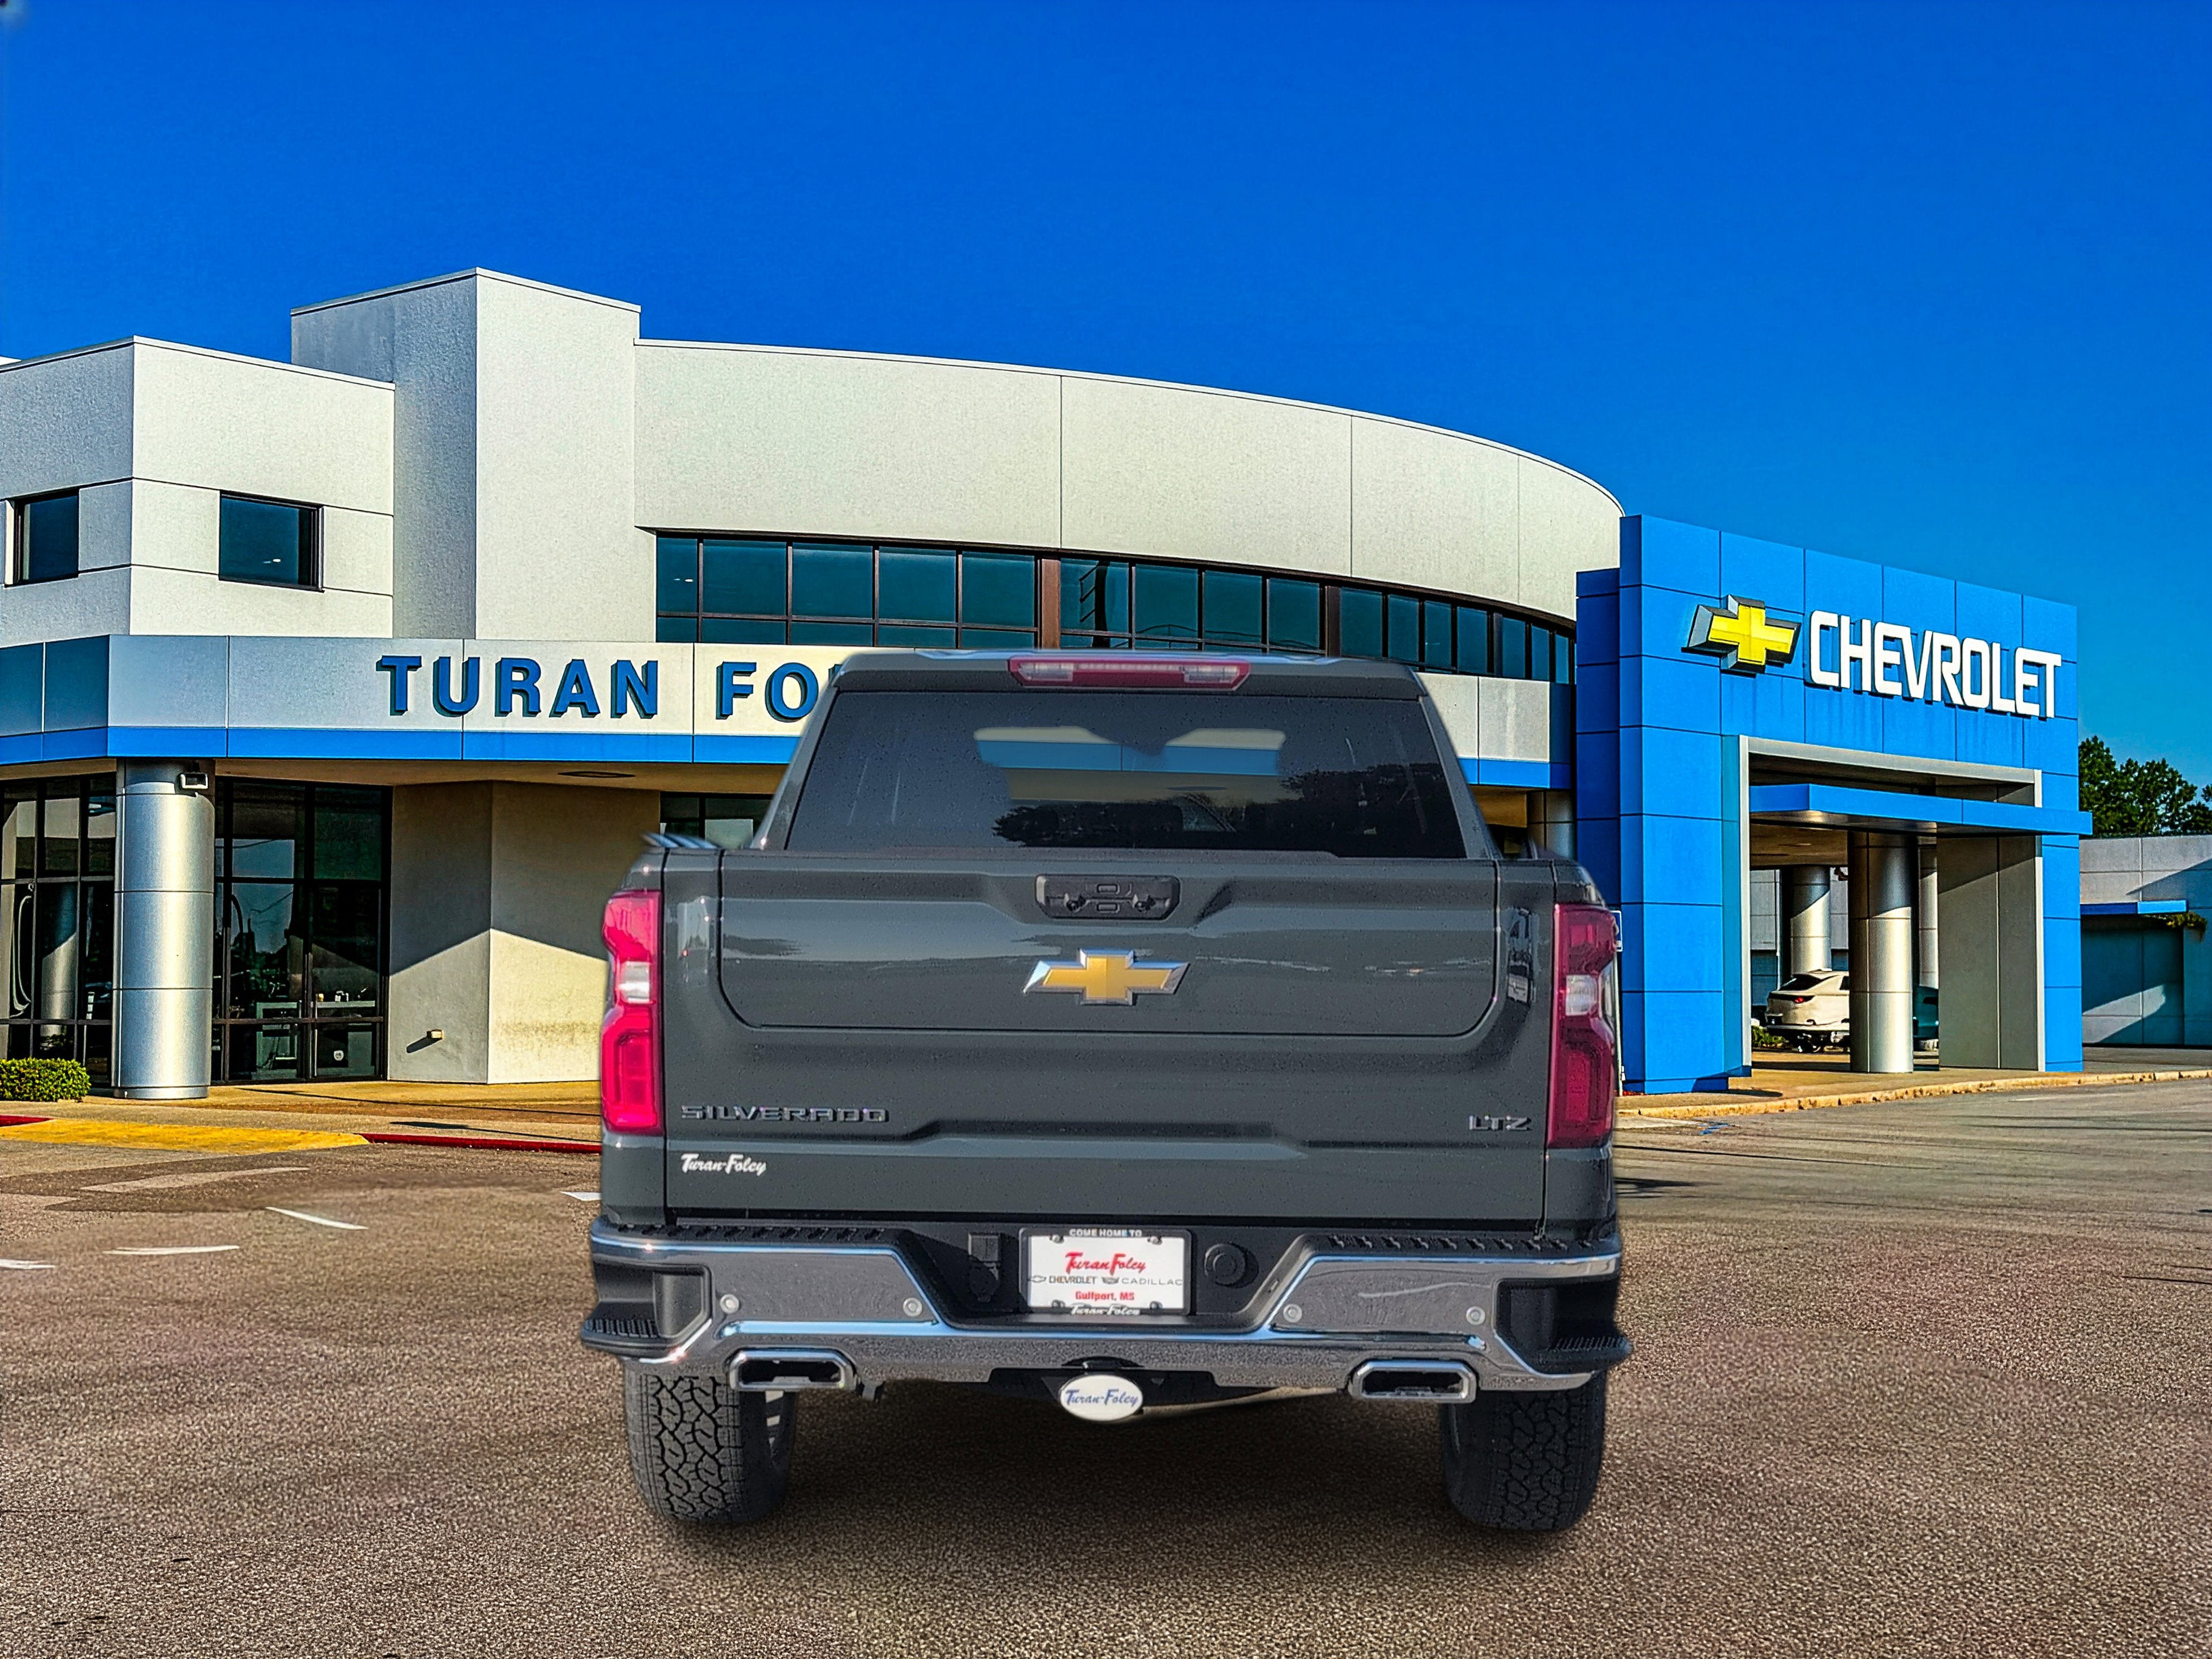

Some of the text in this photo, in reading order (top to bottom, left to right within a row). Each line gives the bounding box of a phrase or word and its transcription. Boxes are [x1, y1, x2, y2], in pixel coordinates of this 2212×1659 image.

[1809, 610, 2062, 718] CHEVROLET
[376, 654, 842, 722] TURAN FO
[681, 1104, 890, 1122] SILVERADO
[1468, 1114, 1532, 1131] LTZ
[1069, 1228, 1097, 1237] COME
[1099, 1229, 1128, 1237] HOME
[1049, 1275, 1184, 1286] CHEVROLET CADILLAC
[1075, 1291, 1135, 1302] Gulfport, MS
